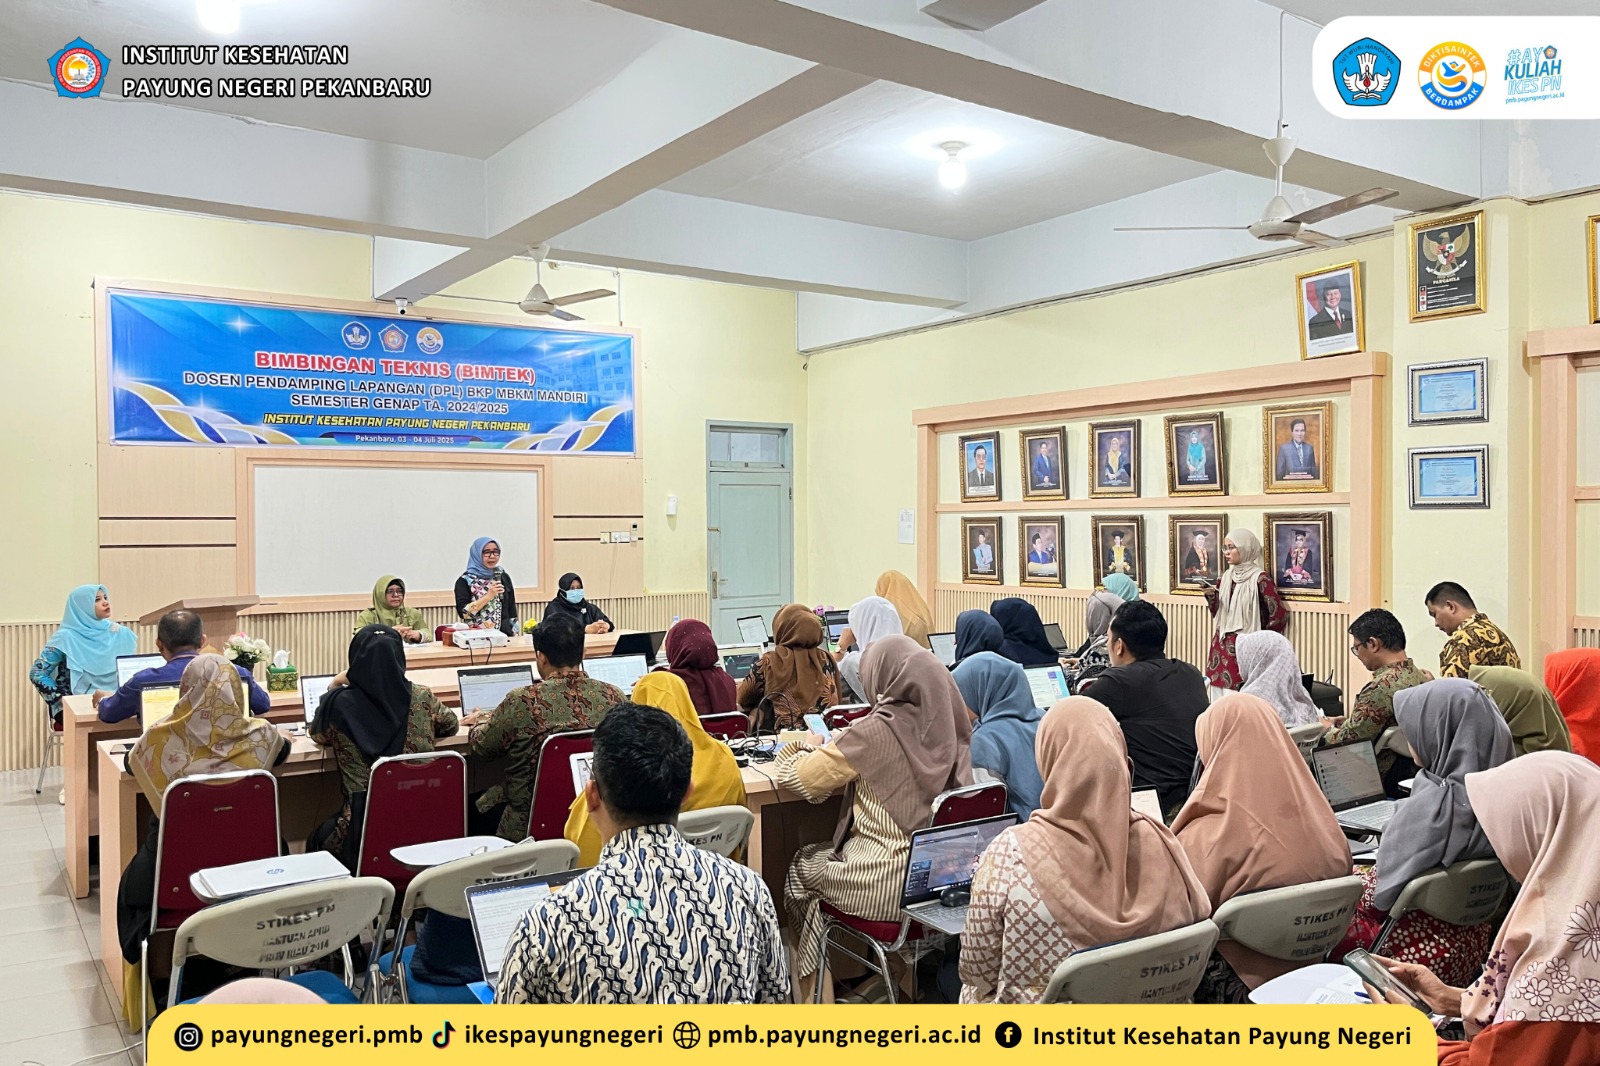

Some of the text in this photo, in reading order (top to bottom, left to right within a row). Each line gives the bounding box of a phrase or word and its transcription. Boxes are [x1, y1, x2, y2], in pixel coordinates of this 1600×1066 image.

[256, 352, 535, 384] BIMBINGAN TEKNIS (BIMTEK)
[184, 372, 587, 403] DOSEN PENDAMPING LAPANGAN (DPL) BKP MBKM MANDIRI
[291, 394, 508, 414] SEMESTER GENAP TA. 2024/2025
[263, 413, 530, 431] INSTITUT KESEHATAN PAYUNG NEGERI PEKANBARU
[424, 436, 436, 444] Juli
[437, 436, 454, 444] 2025
[710, 833, 722, 842] PN
[257, 909, 311, 930] STIKES
[1294, 911, 1335, 926] STIKES
[1140, 957, 1186, 978] STIKES
